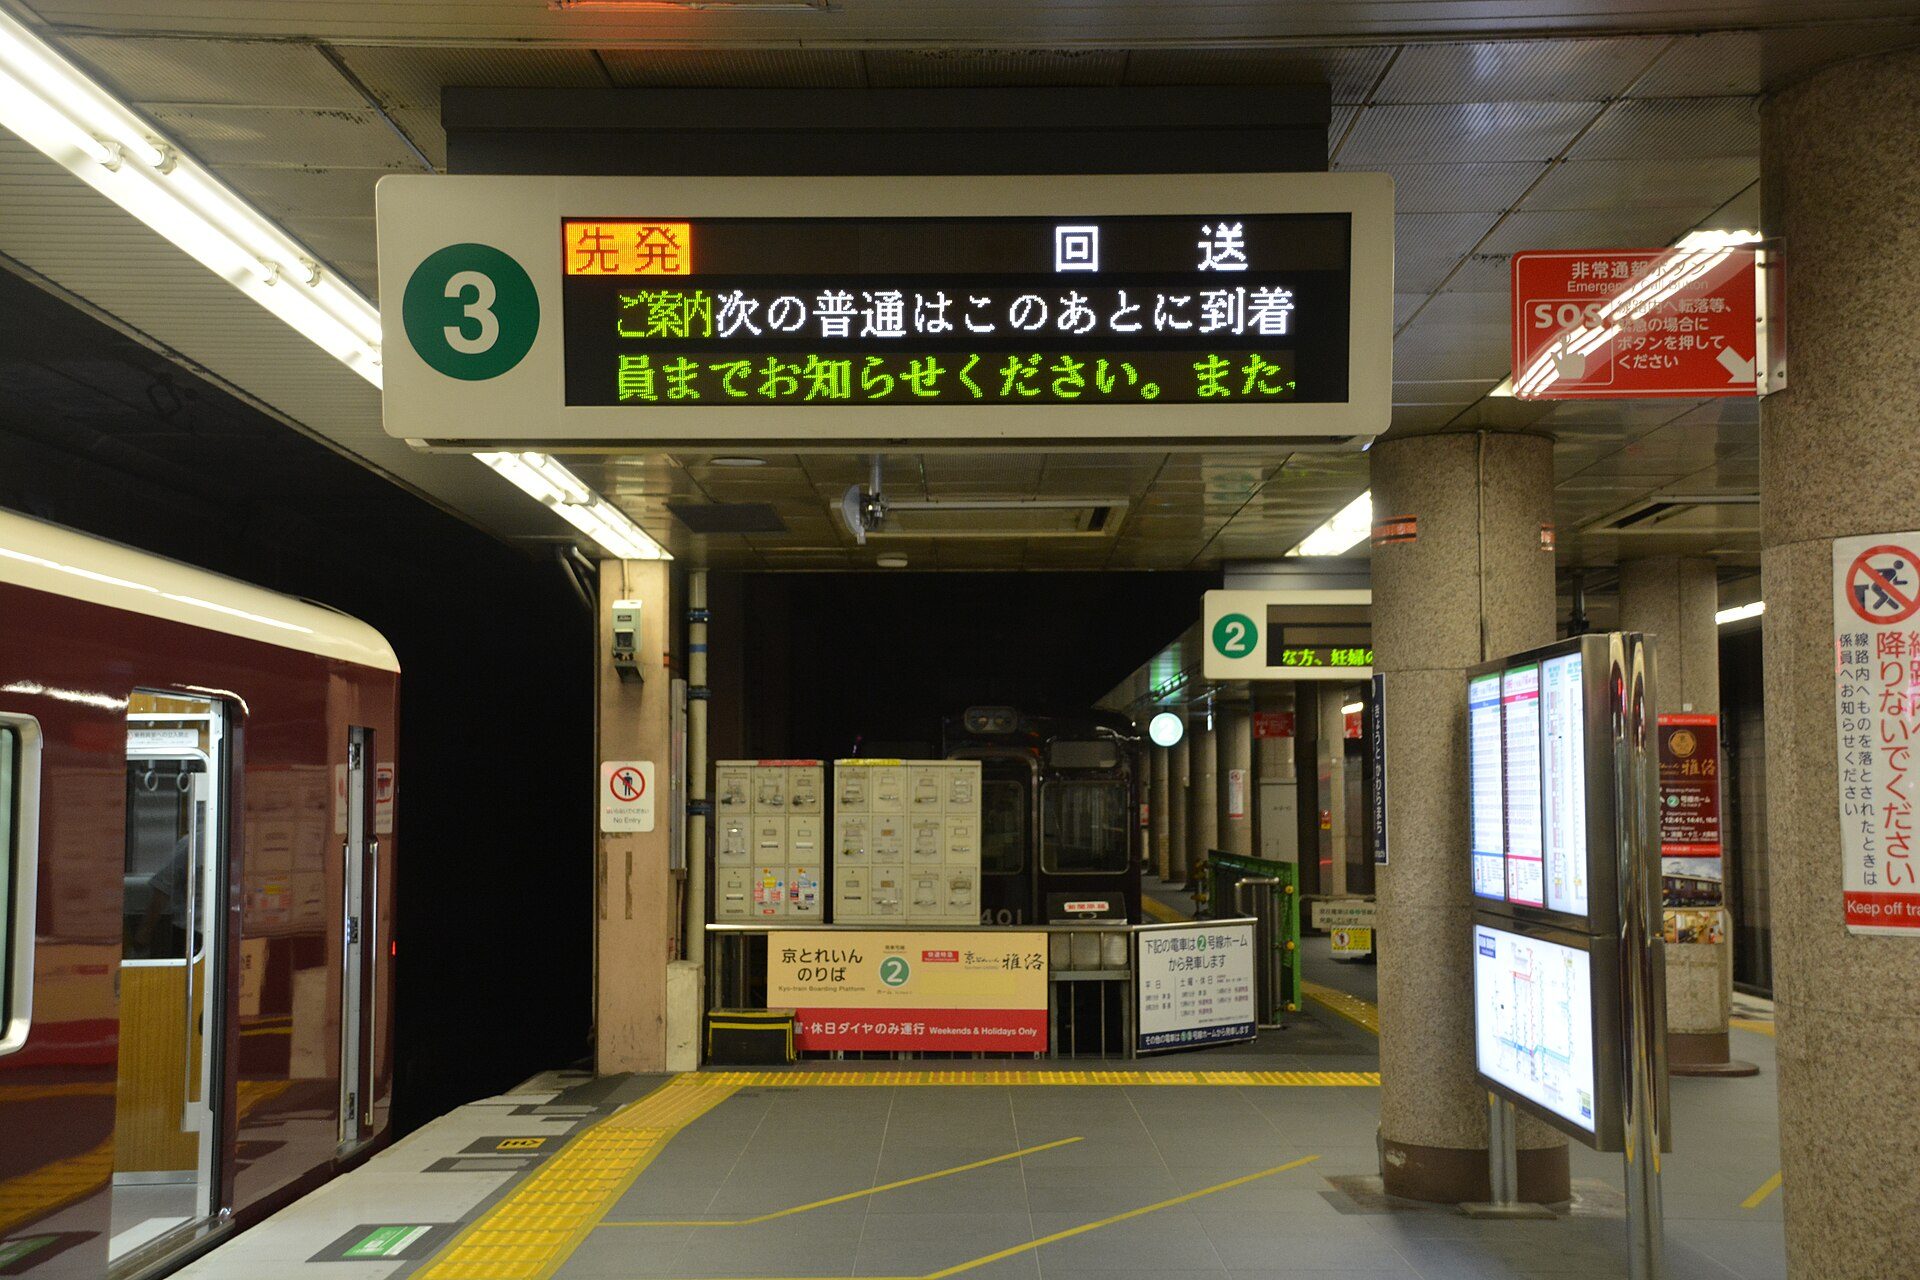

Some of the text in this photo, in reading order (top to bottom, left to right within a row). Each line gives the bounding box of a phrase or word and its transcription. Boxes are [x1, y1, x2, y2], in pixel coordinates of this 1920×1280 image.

[576, 227, 681, 272] 先発
[442, 271, 499, 353] 3
[1535, 303, 1602, 329] SOS
[1617, 335, 1725, 350] ボタンを押して
[1618, 355, 1679, 369] ください
[1225, 621, 1246, 651] 2
[1840, 633, 1858, 816] 係員へお知らせください
[1855, 632, 1877, 885] 線路内へものを落とされたときは
[1877, 632, 1915, 886] 降りないでください
[1847, 900, 1880, 917] Keep
[1884, 902, 1903, 915] off
[782, 948, 863, 964] 京とれいん
[1168, 955, 1226, 971] から発車します
[797, 967, 846, 982] のりば
[886, 960, 903, 983] 2
[929, 1027, 1038, 1037] Weekends & Holidays Only
